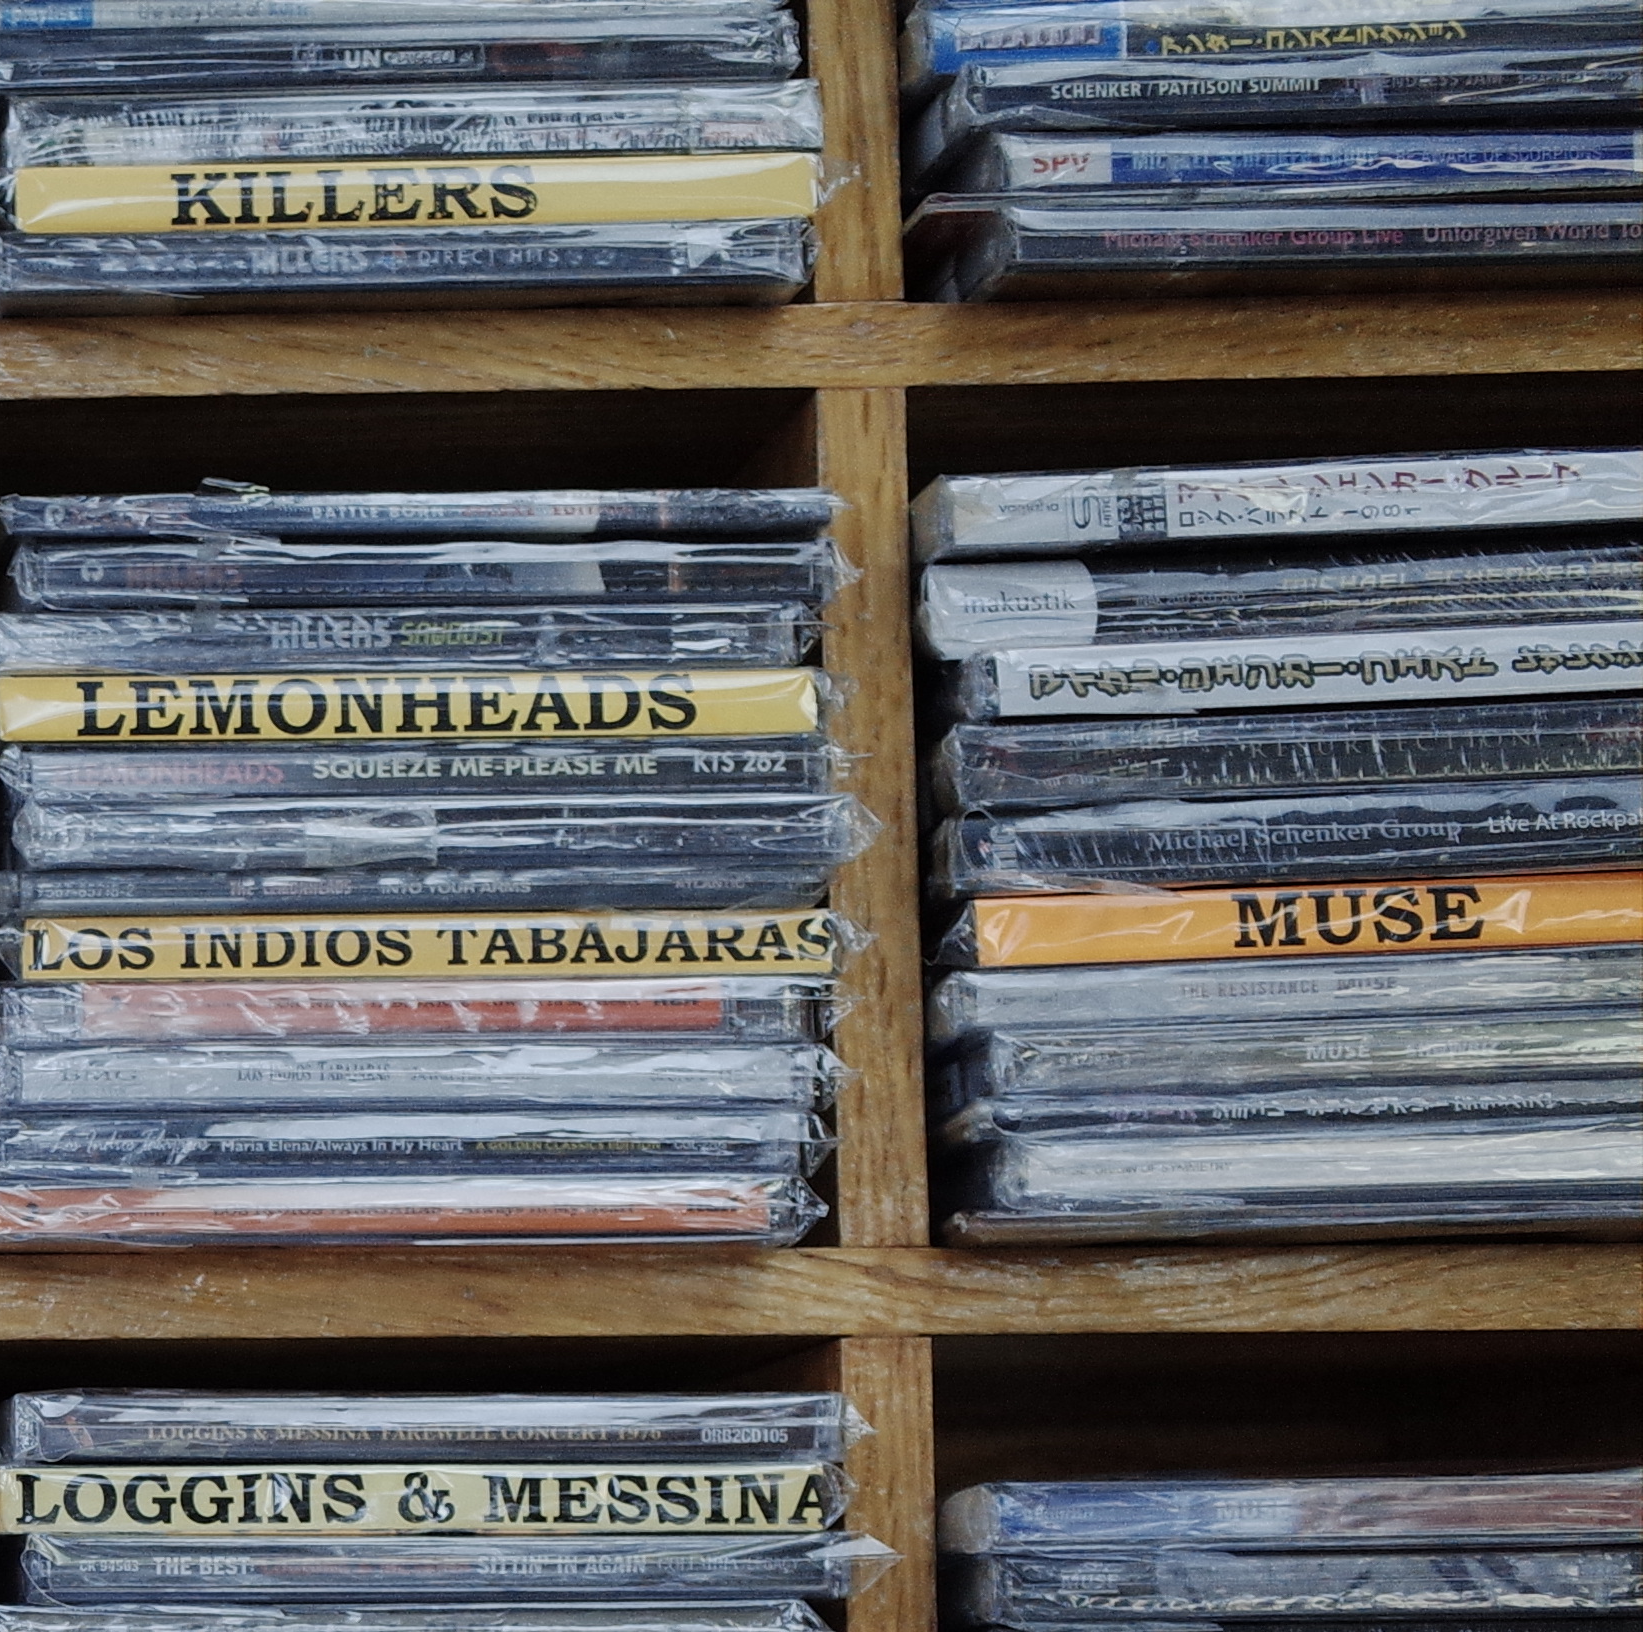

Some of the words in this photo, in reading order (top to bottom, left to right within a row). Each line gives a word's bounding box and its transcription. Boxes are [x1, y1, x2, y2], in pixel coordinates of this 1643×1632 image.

[1050, 82, 1141, 100] SCHENKER
[1147, 81, 1155, 97] /
[1159, 79, 1243, 97] PATTISON
[1249, 77, 1321, 94] SUMMIT
[171, 166, 538, 225] KILLERS
[76, 670, 698, 737] LEMONHEADS
[311, 759, 441, 779] SQUEEZE
[451, 756, 606, 778] ME-PLEASE
[615, 756, 656, 775] ME
[693, 752, 734, 773] KTS
[742, 751, 787, 773] 262
[1147, 830, 1247, 851] Michael
[1253, 825, 1375, 844] Schenker
[1381, 820, 1462, 844] Group
[1487, 817, 1523, 833] Live
[1534, 816, 1557, 831] At
[29, 928, 156, 972] LOS
[183, 926, 412, 970] INDIOS
[437, 916, 831, 969] TABAJARAS
[1232, 885, 1485, 949] MUSE
[221, 1139, 266, 1153] Maria
[271, 1139, 370, 1156] Elena/Always
[374, 1139, 387, 1151] In
[393, 1139, 414, 1154] My
[419, 1138, 463, 1151] Heart
[15, 1473, 366, 1526] LOGGINS
[402, 1471, 454, 1524] &
[484, 1469, 825, 1526] MESSINA
